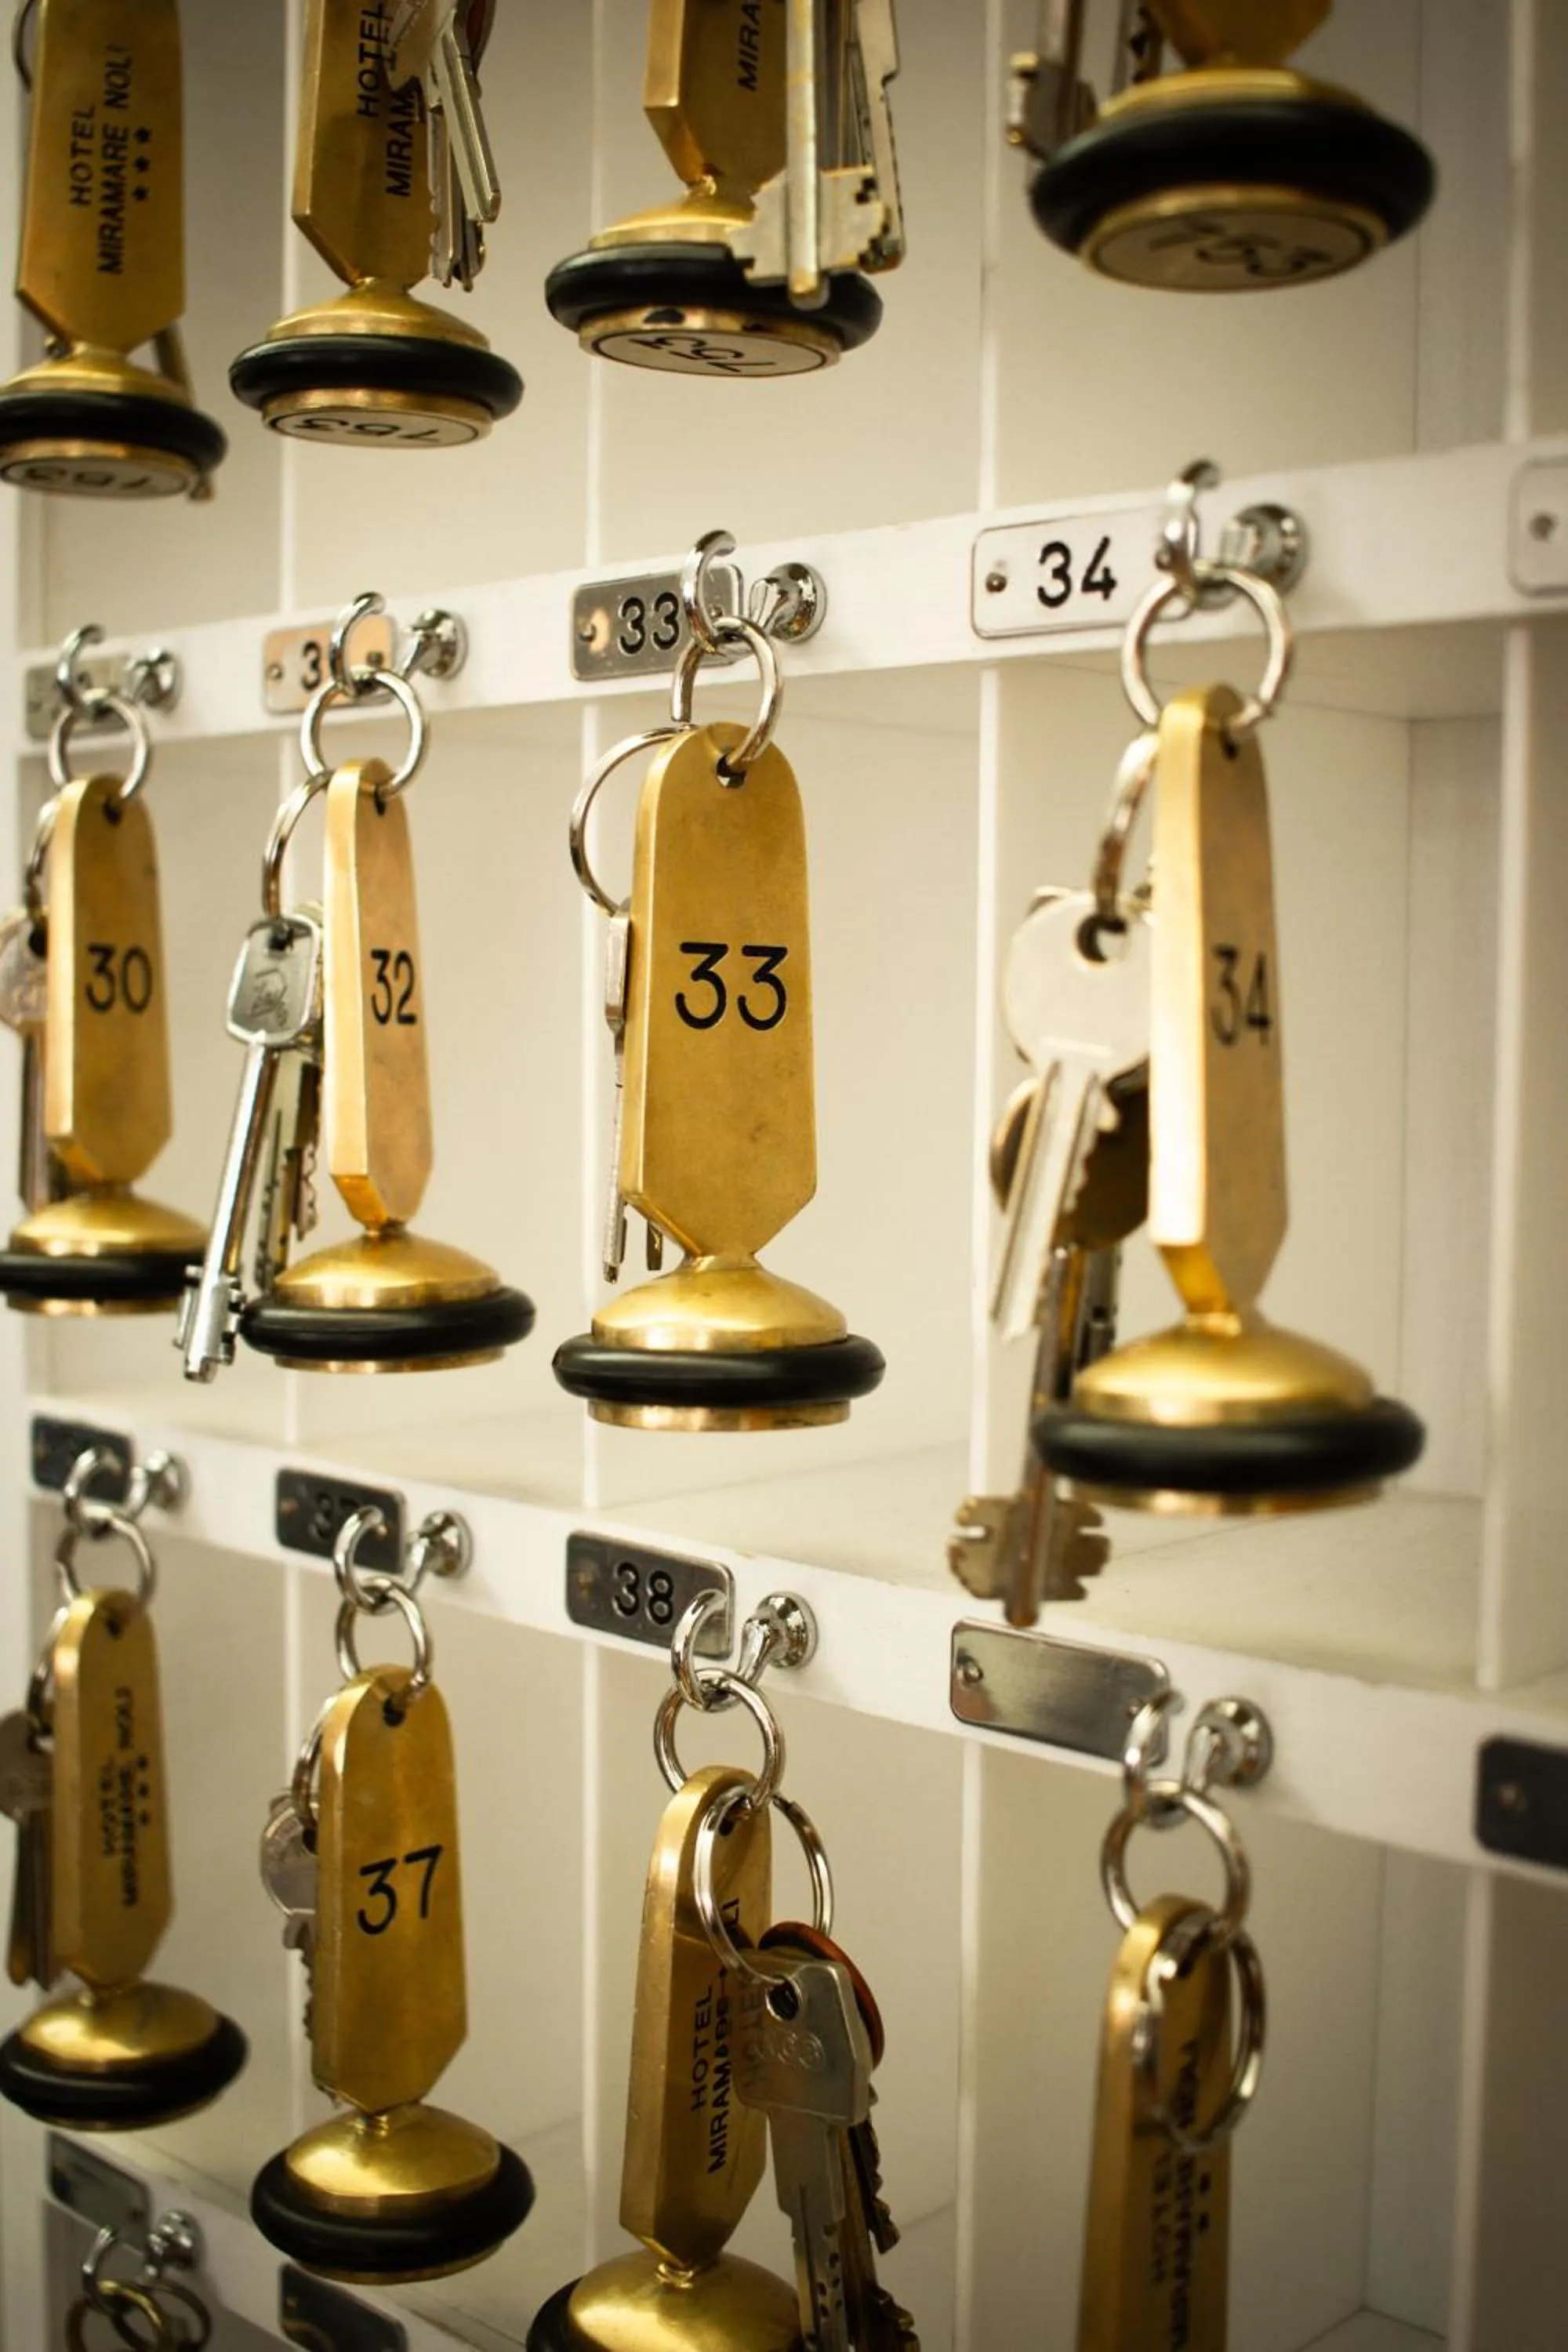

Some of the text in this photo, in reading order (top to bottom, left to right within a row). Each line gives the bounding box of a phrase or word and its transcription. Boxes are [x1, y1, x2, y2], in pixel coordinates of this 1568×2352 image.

[356, 3, 385, 120] HOTEL
[736, 2, 762, 93] MIRA
[69, 102, 95, 209] HOTEL
[96, 43, 133, 275] MIRAMARE NOLI
[385, 88, 416, 198] MIRAM
[1036, 535, 1118, 608] 34
[300, 641, 322, 691] 3
[618, 590, 681, 655] 33
[85, 943, 153, 1014] 30
[370, 948, 418, 1025] 32
[674, 941, 789, 1031] 33
[1211, 944, 1272, 1047] 34
[611, 1561, 675, 1626] 38
[356, 1844, 444, 1936] 37
[691, 1984, 714, 2112] HOTEL
